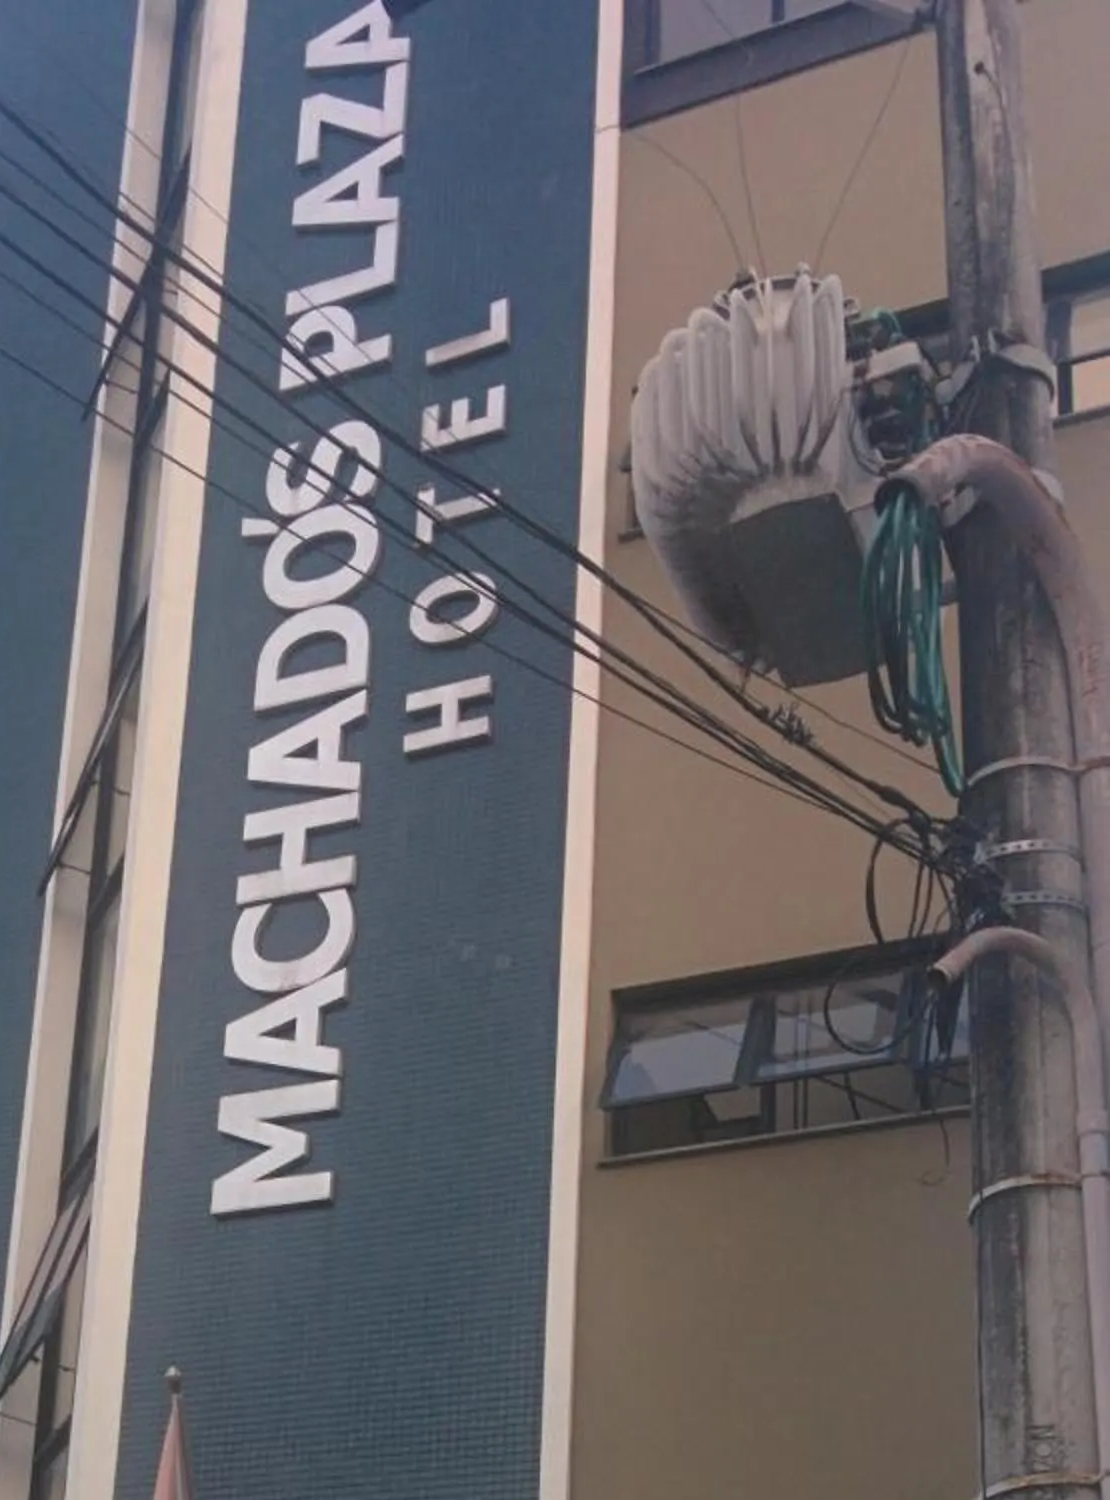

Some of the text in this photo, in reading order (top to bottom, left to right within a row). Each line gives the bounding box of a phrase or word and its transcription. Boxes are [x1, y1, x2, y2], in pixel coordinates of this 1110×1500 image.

[209, 0, 411, 1215] MACHADO'S PLAZA
[402, 297, 511, 756] HOTEL
